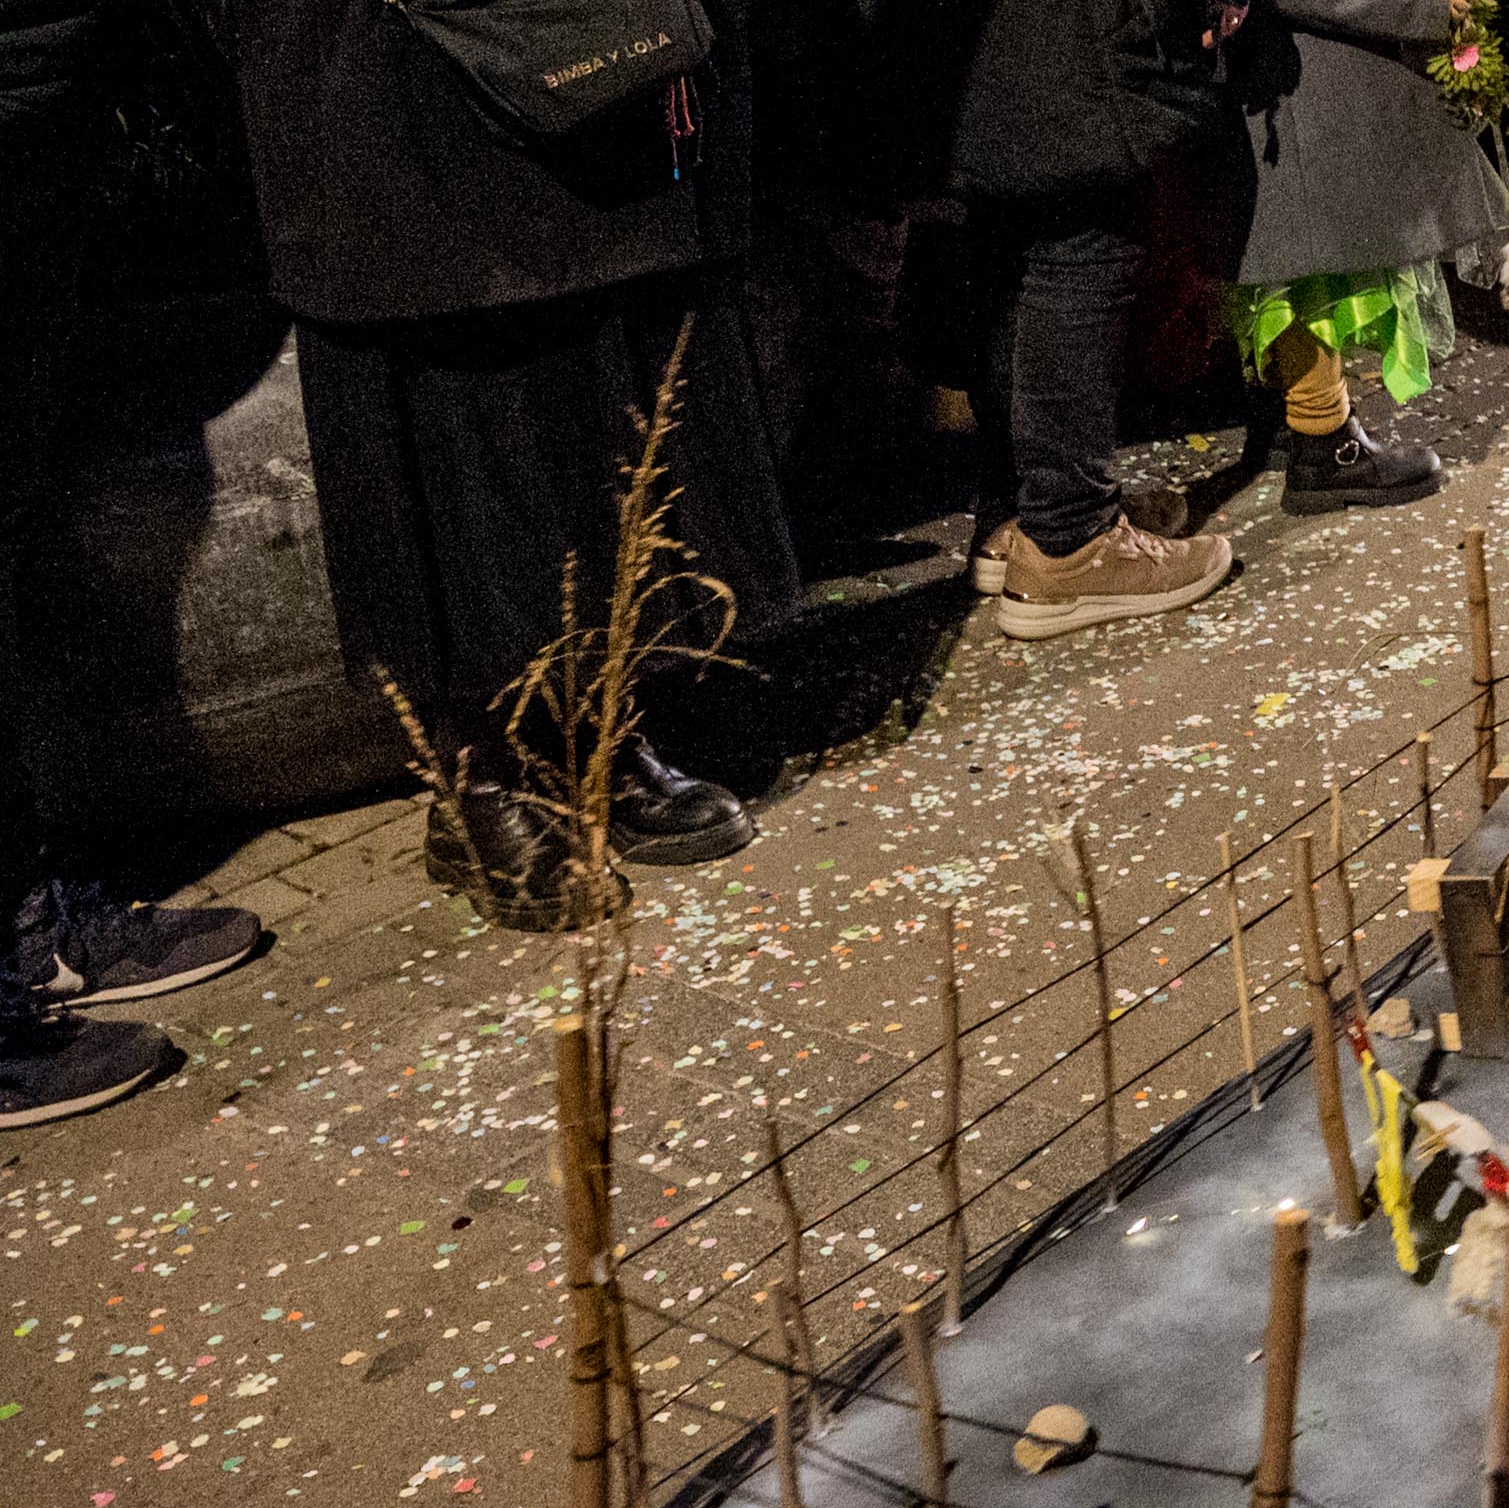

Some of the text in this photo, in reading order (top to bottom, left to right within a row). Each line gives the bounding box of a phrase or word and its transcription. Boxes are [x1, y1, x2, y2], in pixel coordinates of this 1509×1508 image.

[543, 31, 673, 89] BIMBA Y LOLA
